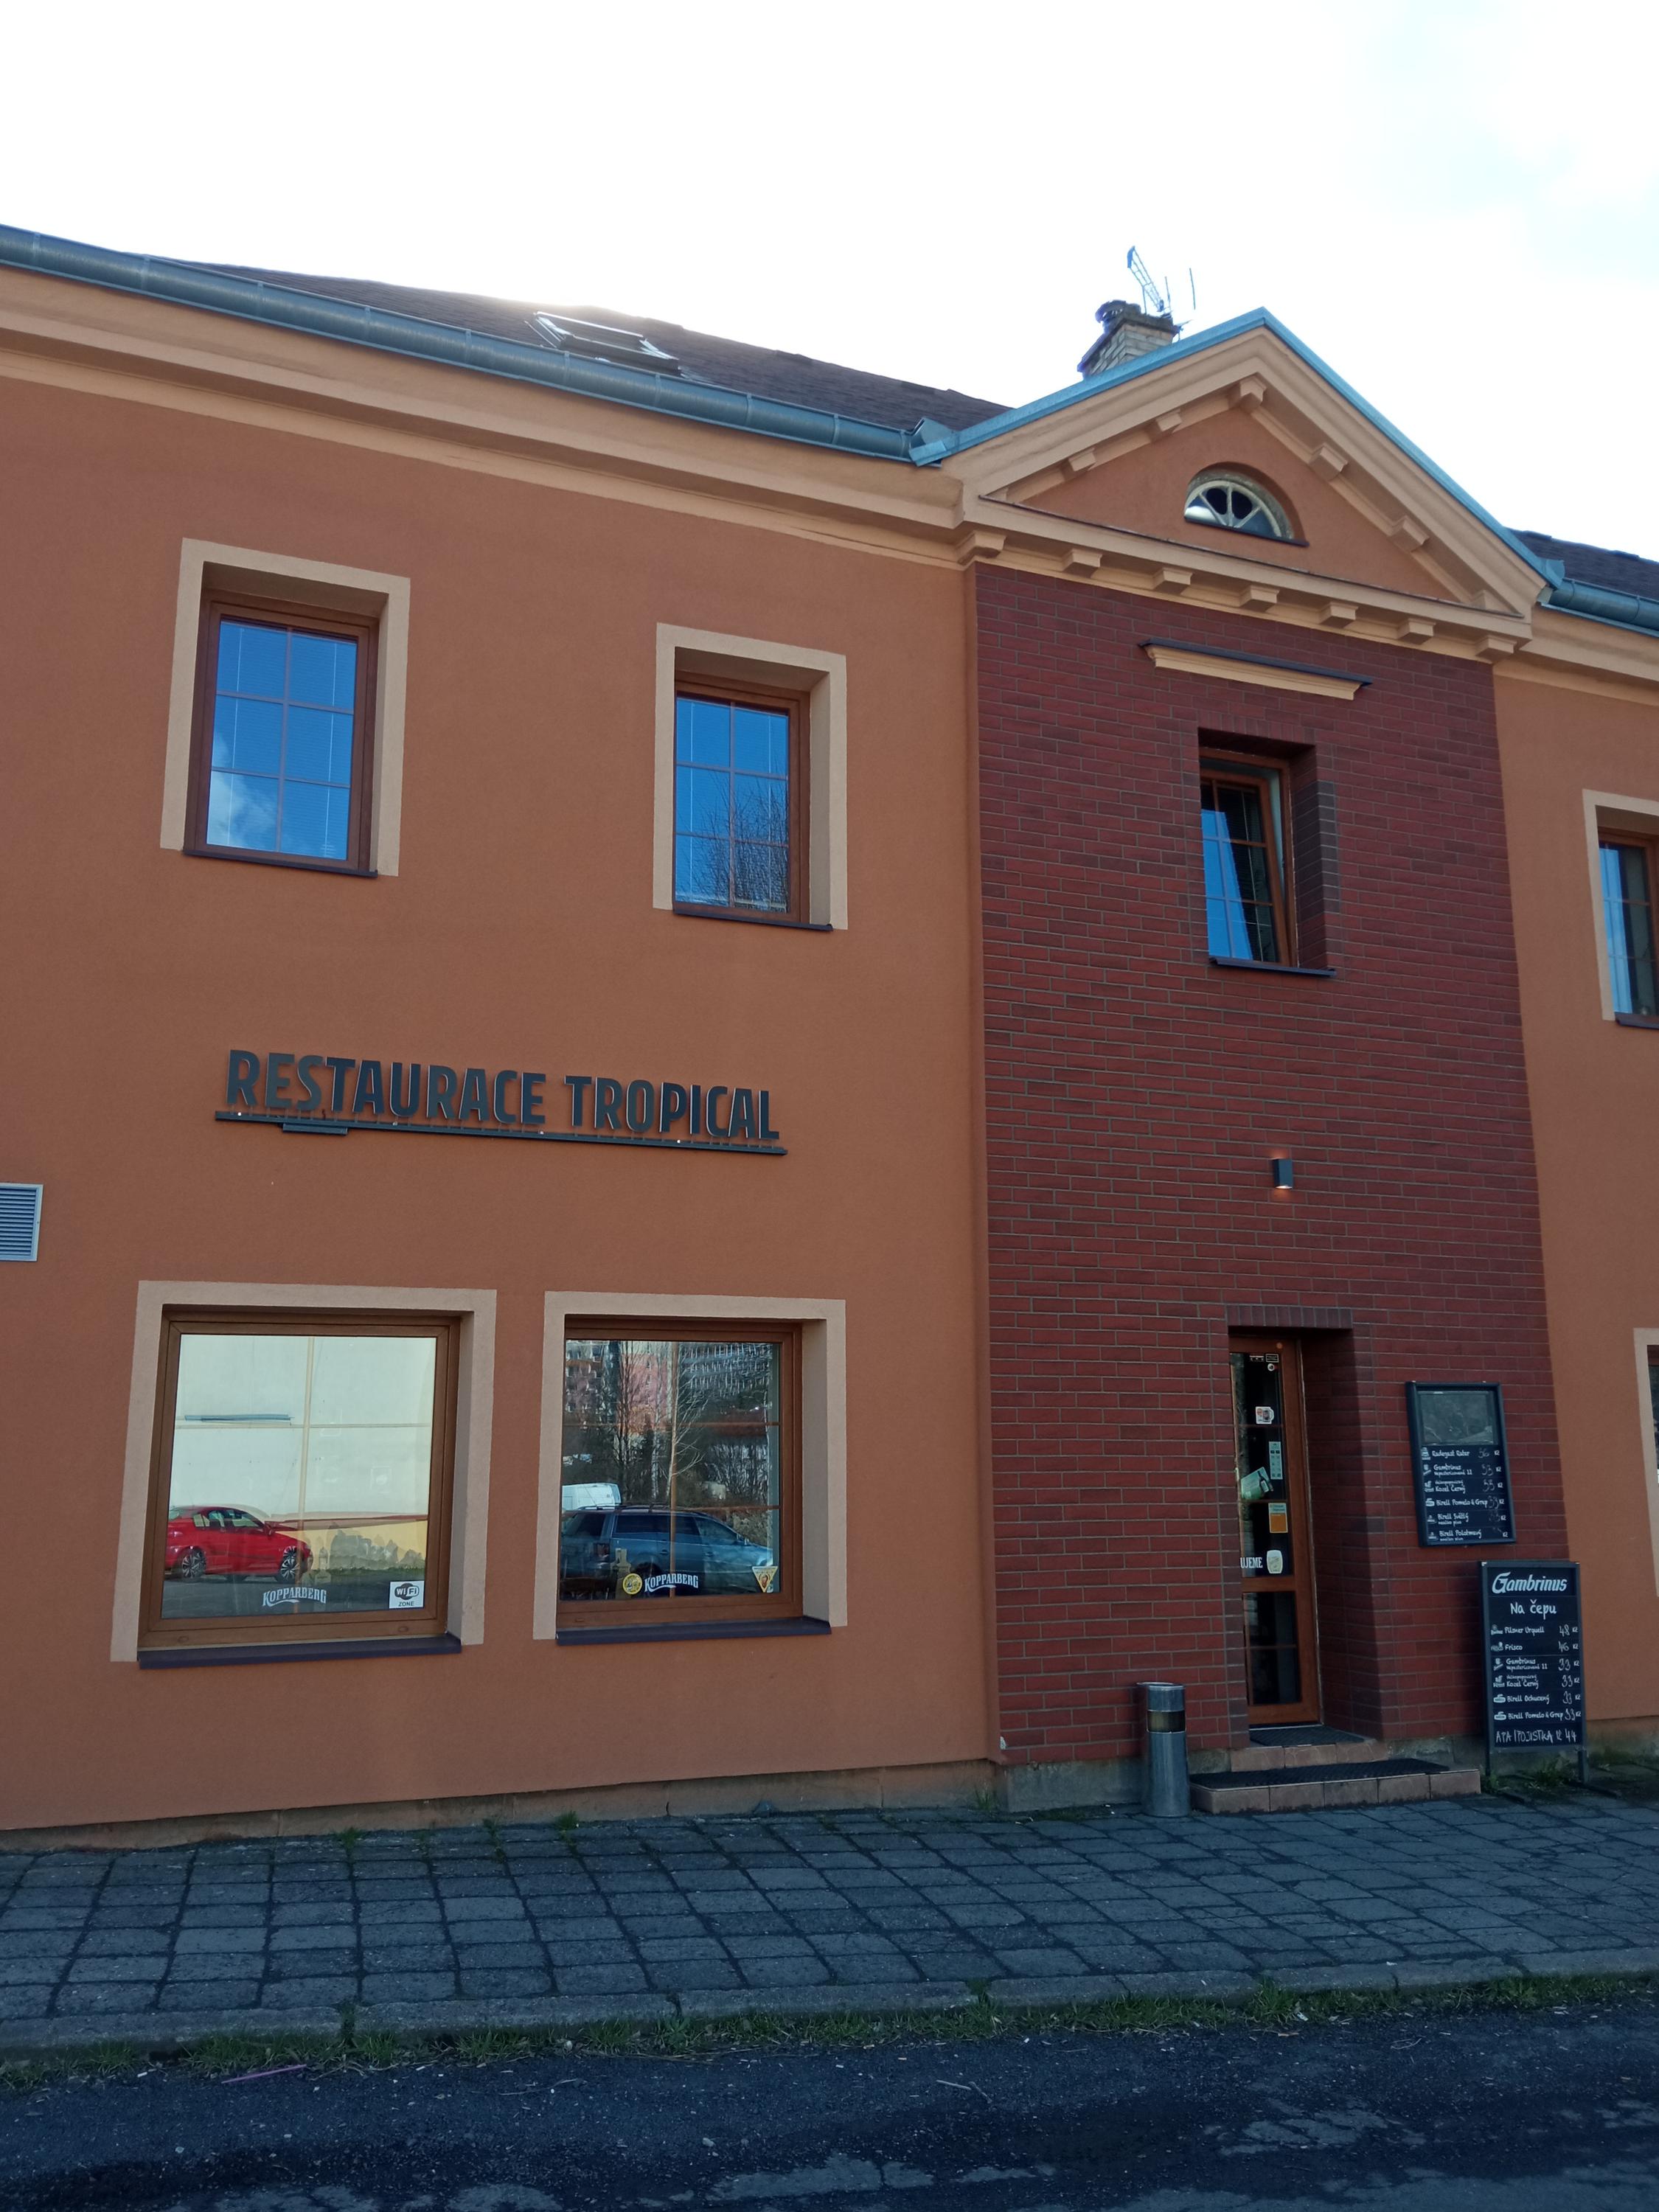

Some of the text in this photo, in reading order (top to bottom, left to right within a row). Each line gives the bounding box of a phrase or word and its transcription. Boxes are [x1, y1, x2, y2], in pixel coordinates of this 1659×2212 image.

[226, 1048, 781, 1141] RESTAURACE TROPICAL
[644, 1573, 699, 1593] KOPPARBERG
[1492, 1571, 1568, 1594] Gambrinus
[262, 1587, 327, 1607] KOPPARBERG
[1510, 1599, 1557, 1620] Na čepu
[1525, 1627, 1545, 1635] Urquell
[1559, 1624, 1571, 1637] 48
[1558, 1641, 1570, 1652] 46
[1558, 1658, 1571, 1671] 33
[1523, 1680, 1540, 1690] Černý
[1562, 1674, 1573, 1687] 33
[1525, 1694, 1550, 1705] Ochucený
[1562, 1691, 1573, 1705] 33
[1550, 1711, 1564, 1721] Grep
[1496, 1731, 1512, 1743] APA
[1565, 1728, 1576, 1743] 44
